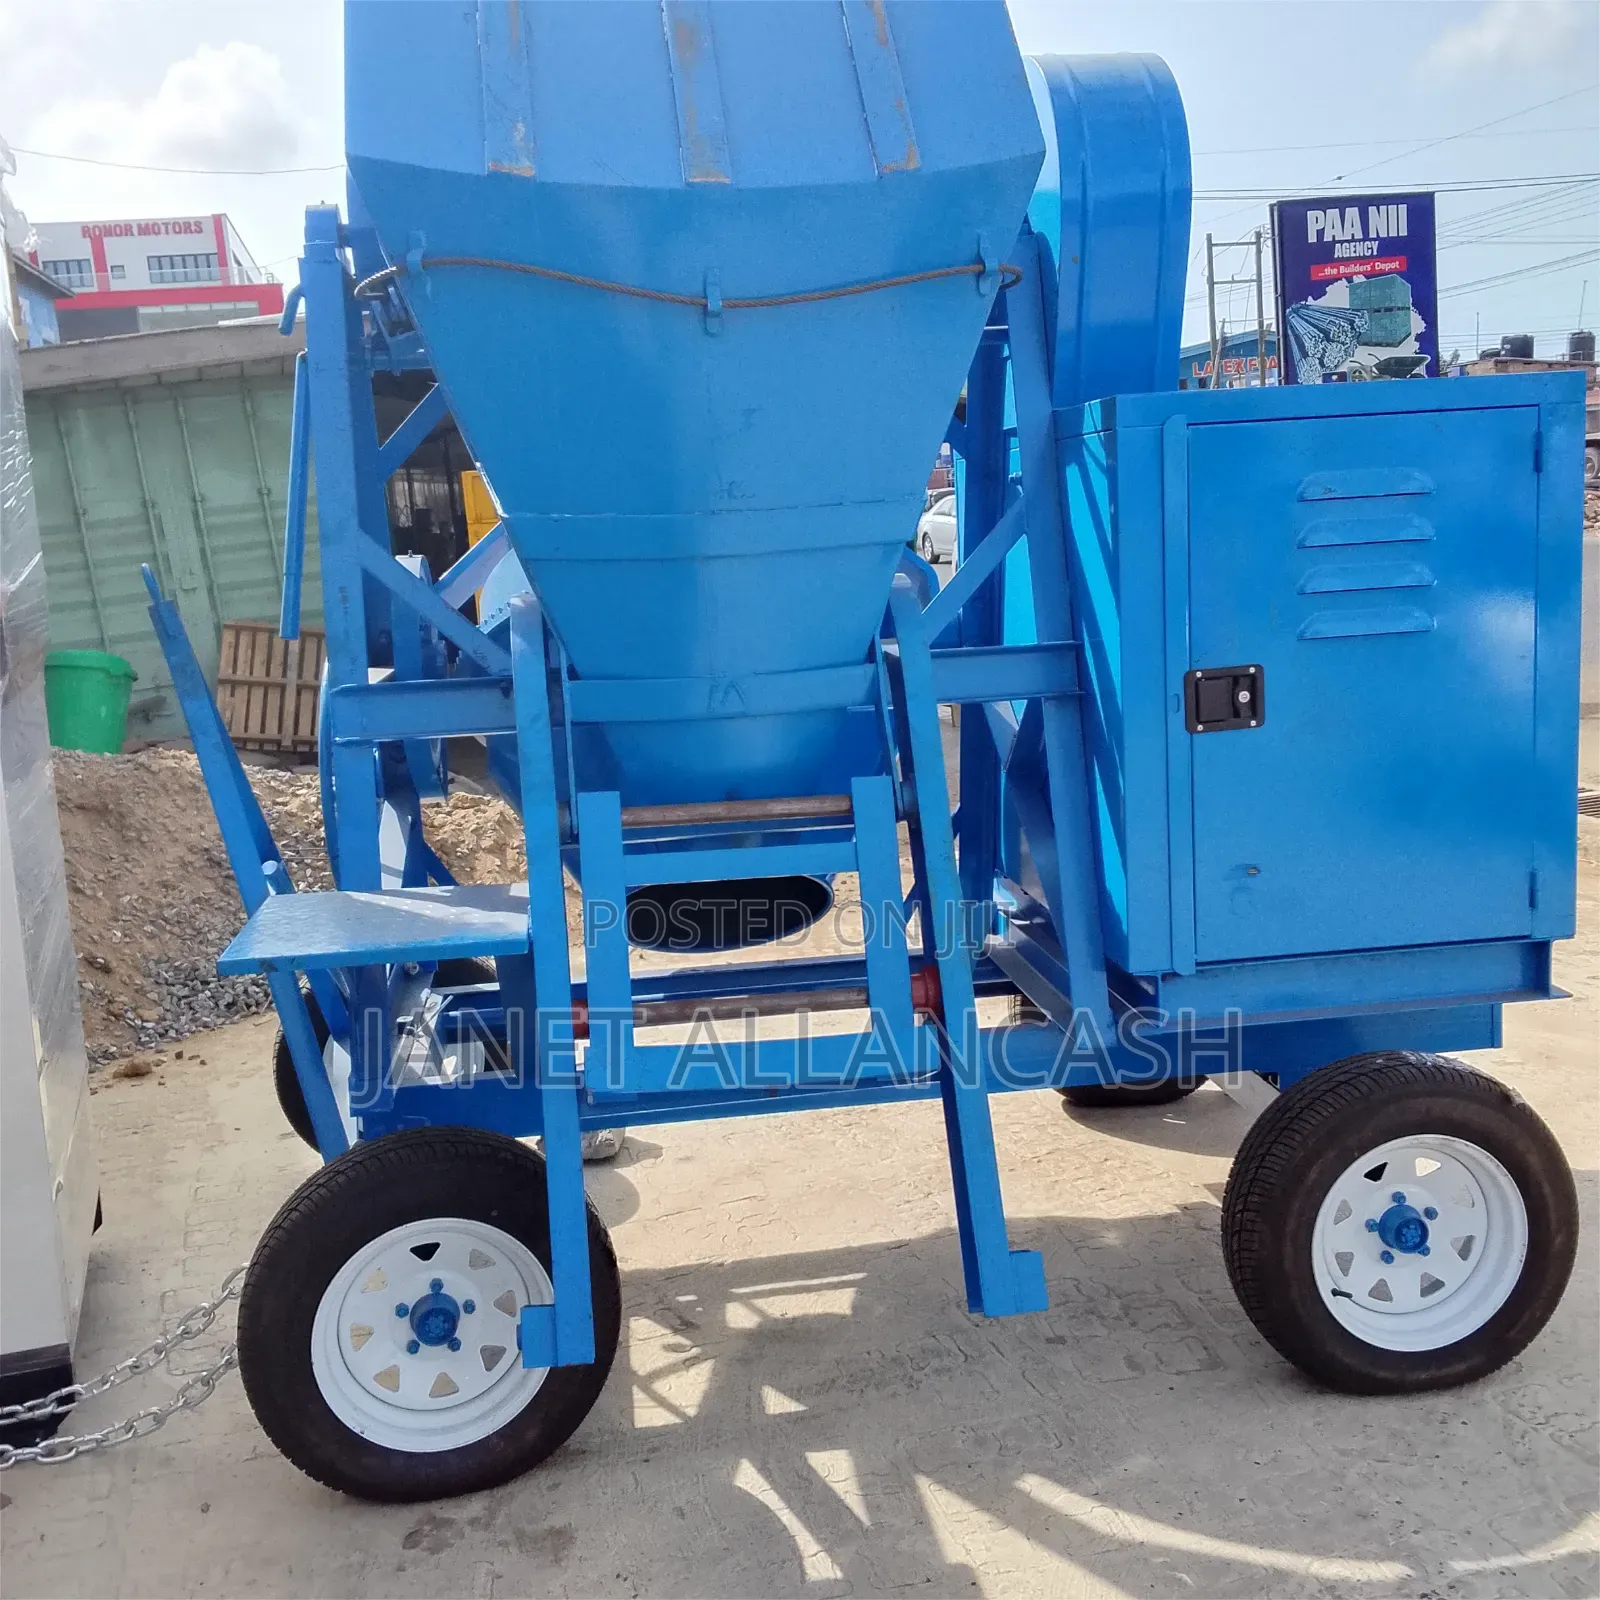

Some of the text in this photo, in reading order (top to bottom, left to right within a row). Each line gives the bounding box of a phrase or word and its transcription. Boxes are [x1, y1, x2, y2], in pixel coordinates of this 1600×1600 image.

[136, 220, 204, 236] MOTORS
[1307, 204, 1407, 243] PAA NII
[1334, 241, 1379, 258] AGENCY
[1375, 260, 1400, 272] Depot
[1192, 358, 1246, 378] LAEX
